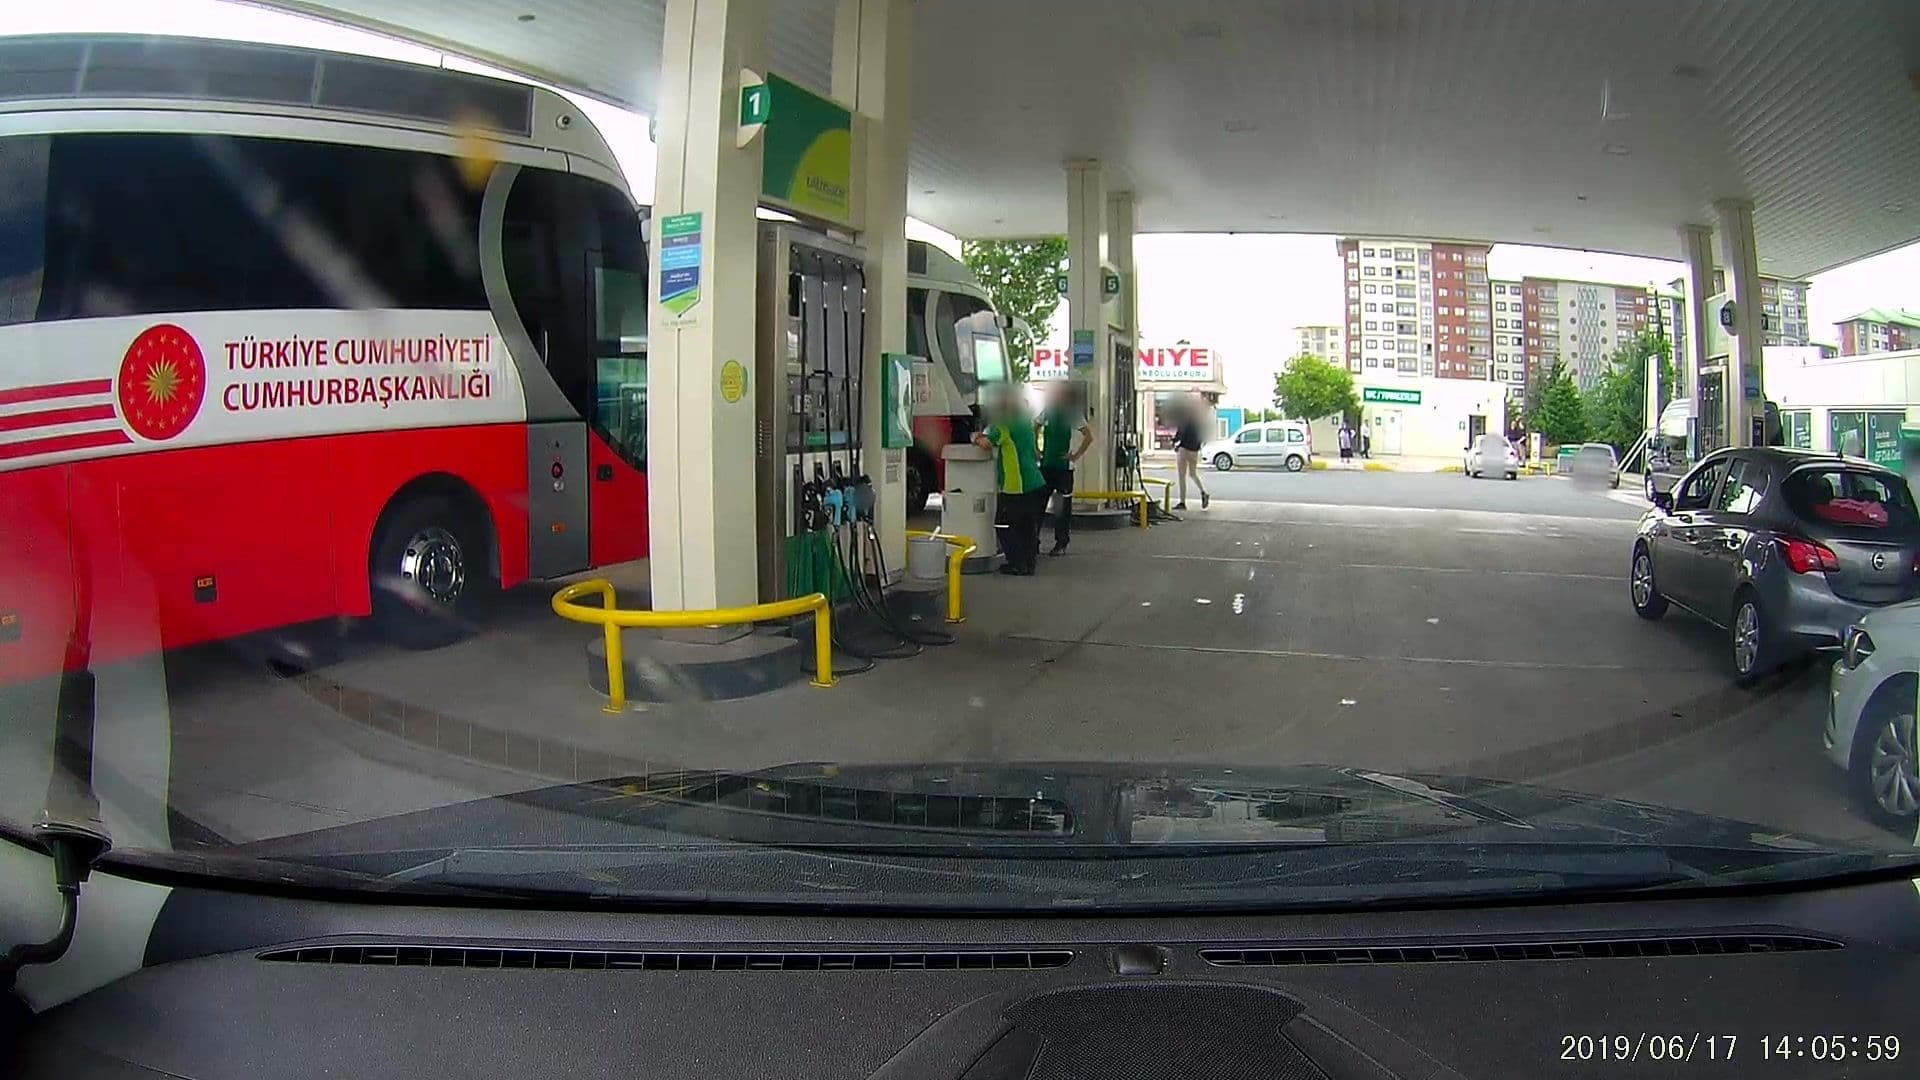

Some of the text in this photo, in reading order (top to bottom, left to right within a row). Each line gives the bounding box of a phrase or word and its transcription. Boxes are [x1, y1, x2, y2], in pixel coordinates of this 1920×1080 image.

[749, 92, 760, 115] 1
[1058, 278, 1066, 291] 6
[1108, 278, 1116, 291] 5
[225, 333, 490, 370] TÜRKİYE CUMHURİYETİ
[223, 368, 491, 411] CUMHURBAŞKANLIĞI
